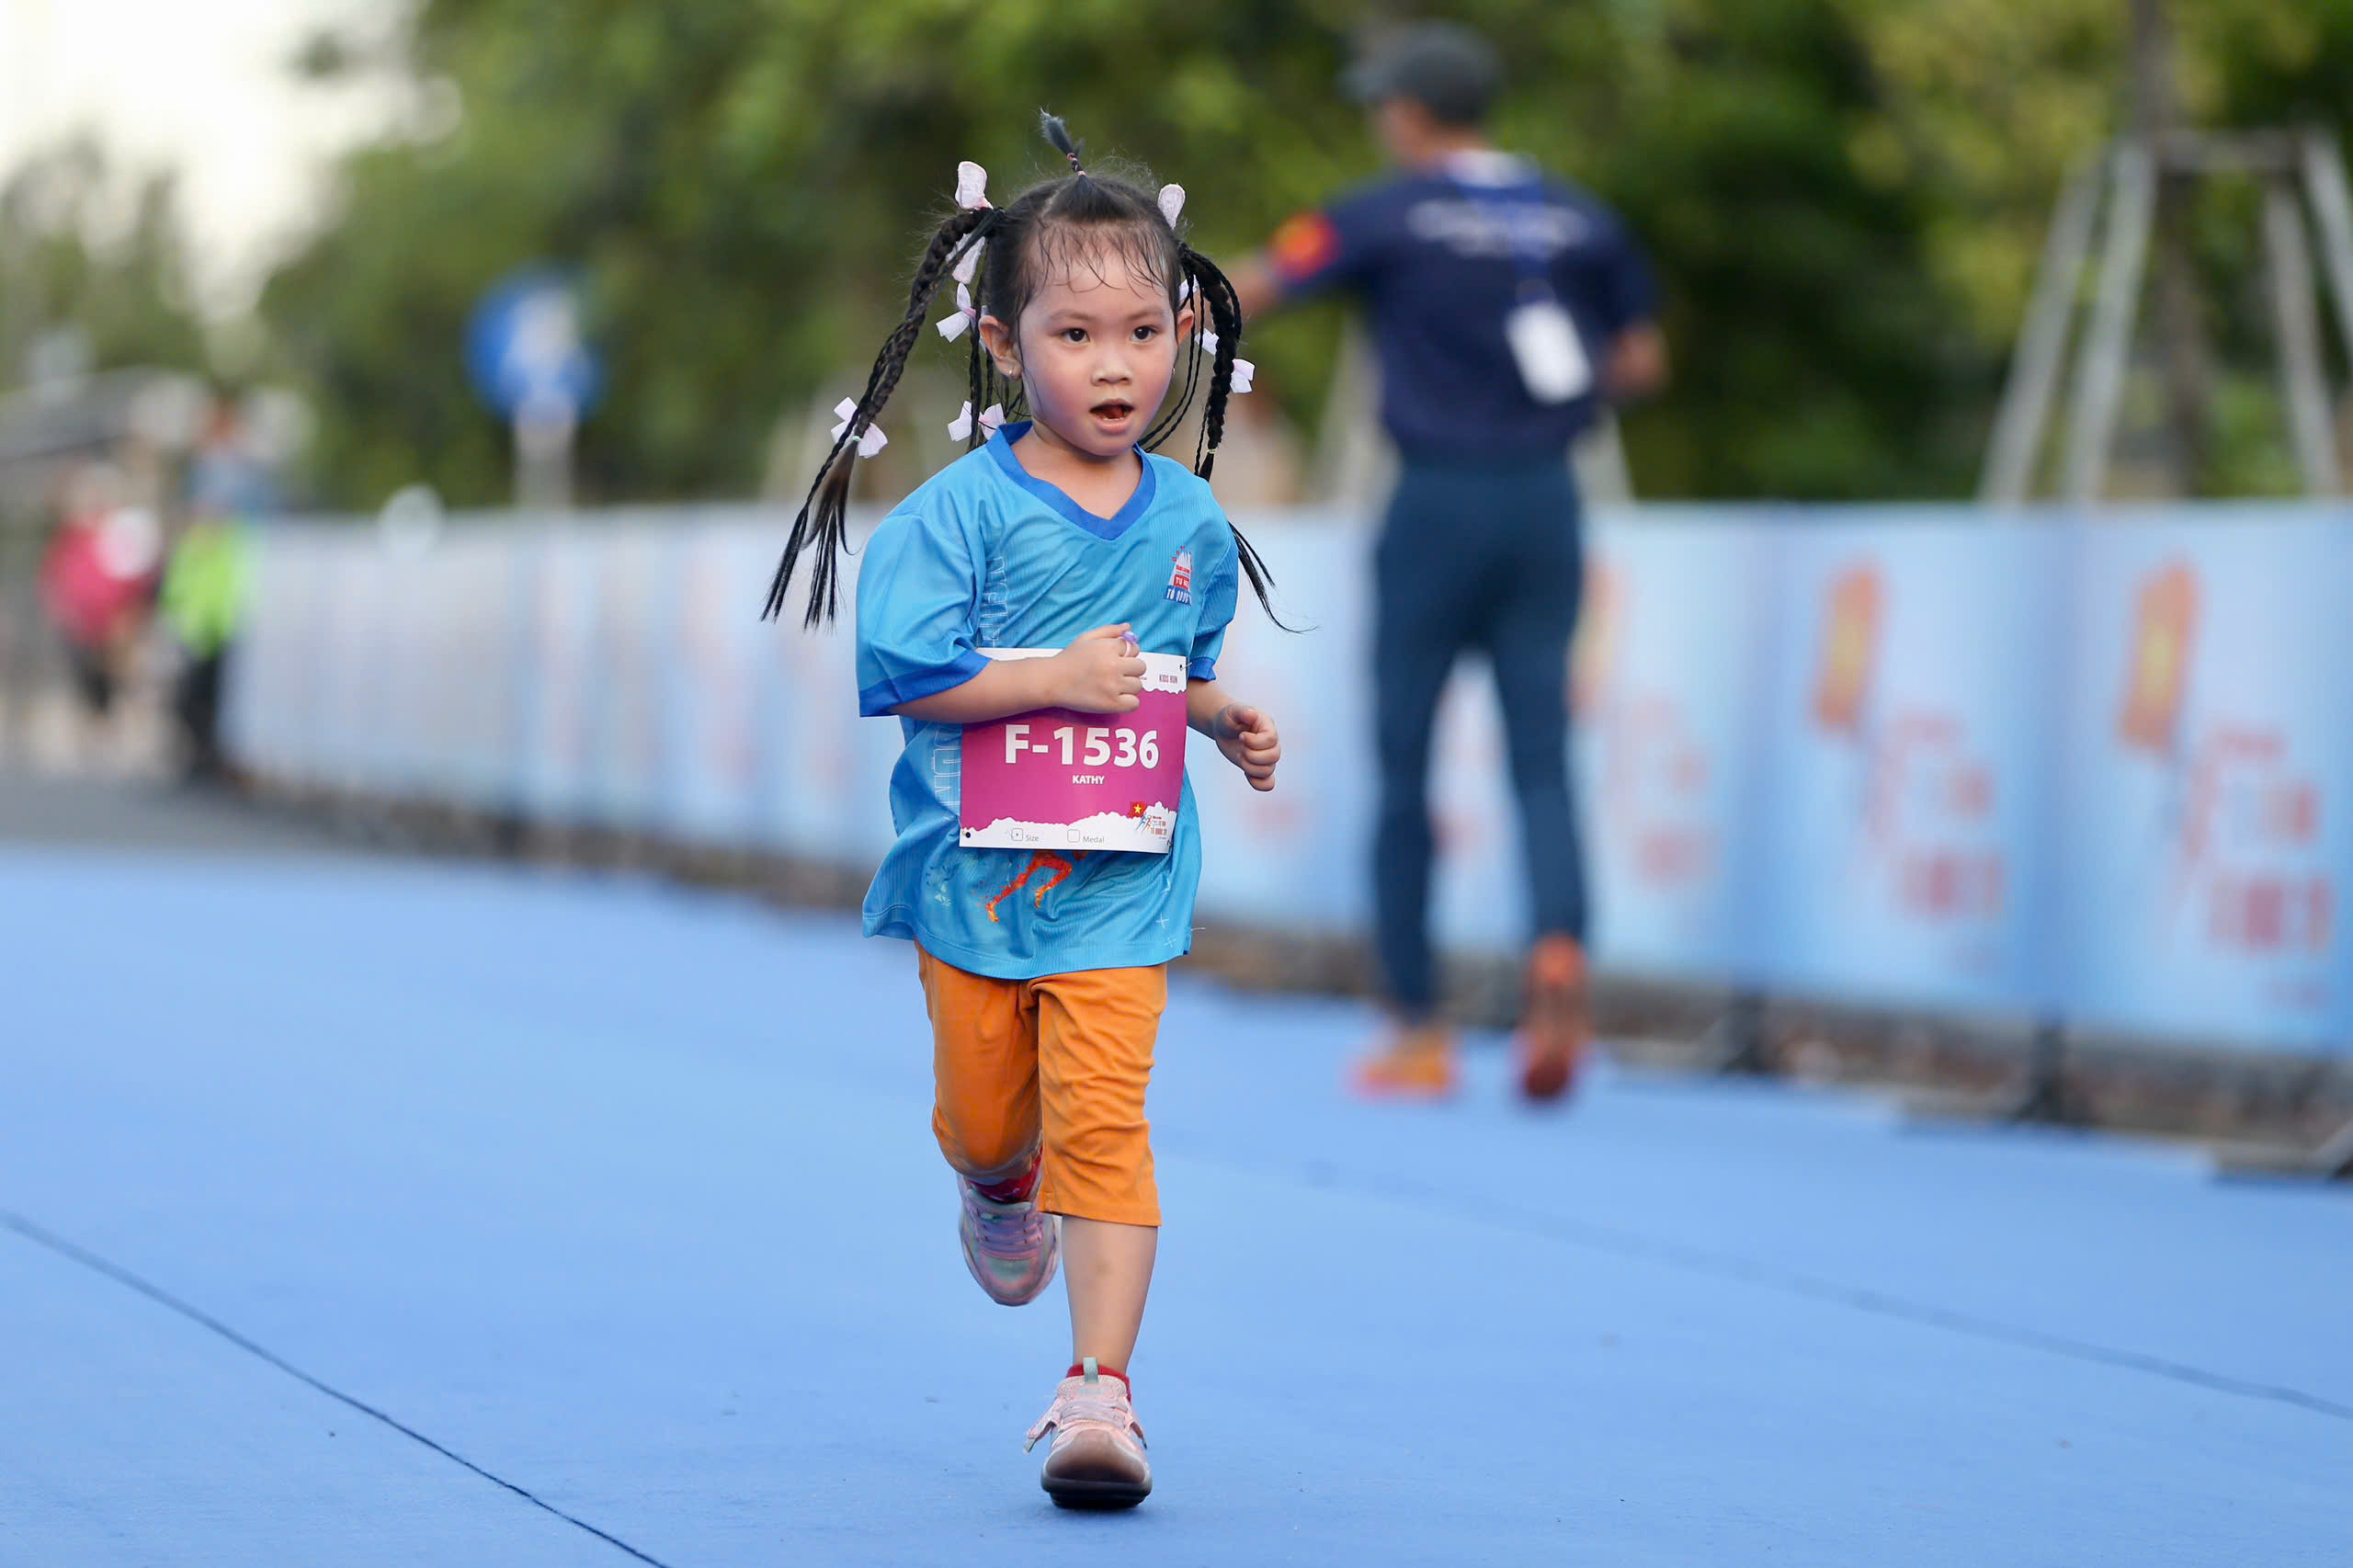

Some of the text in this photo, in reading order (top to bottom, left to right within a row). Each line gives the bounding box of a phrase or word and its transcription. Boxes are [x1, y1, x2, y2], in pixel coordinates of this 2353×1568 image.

[1005, 723, 1160, 769] F-1536
[1072, 775, 1105, 785] KATHY
[1025, 834, 1040, 843] Size
